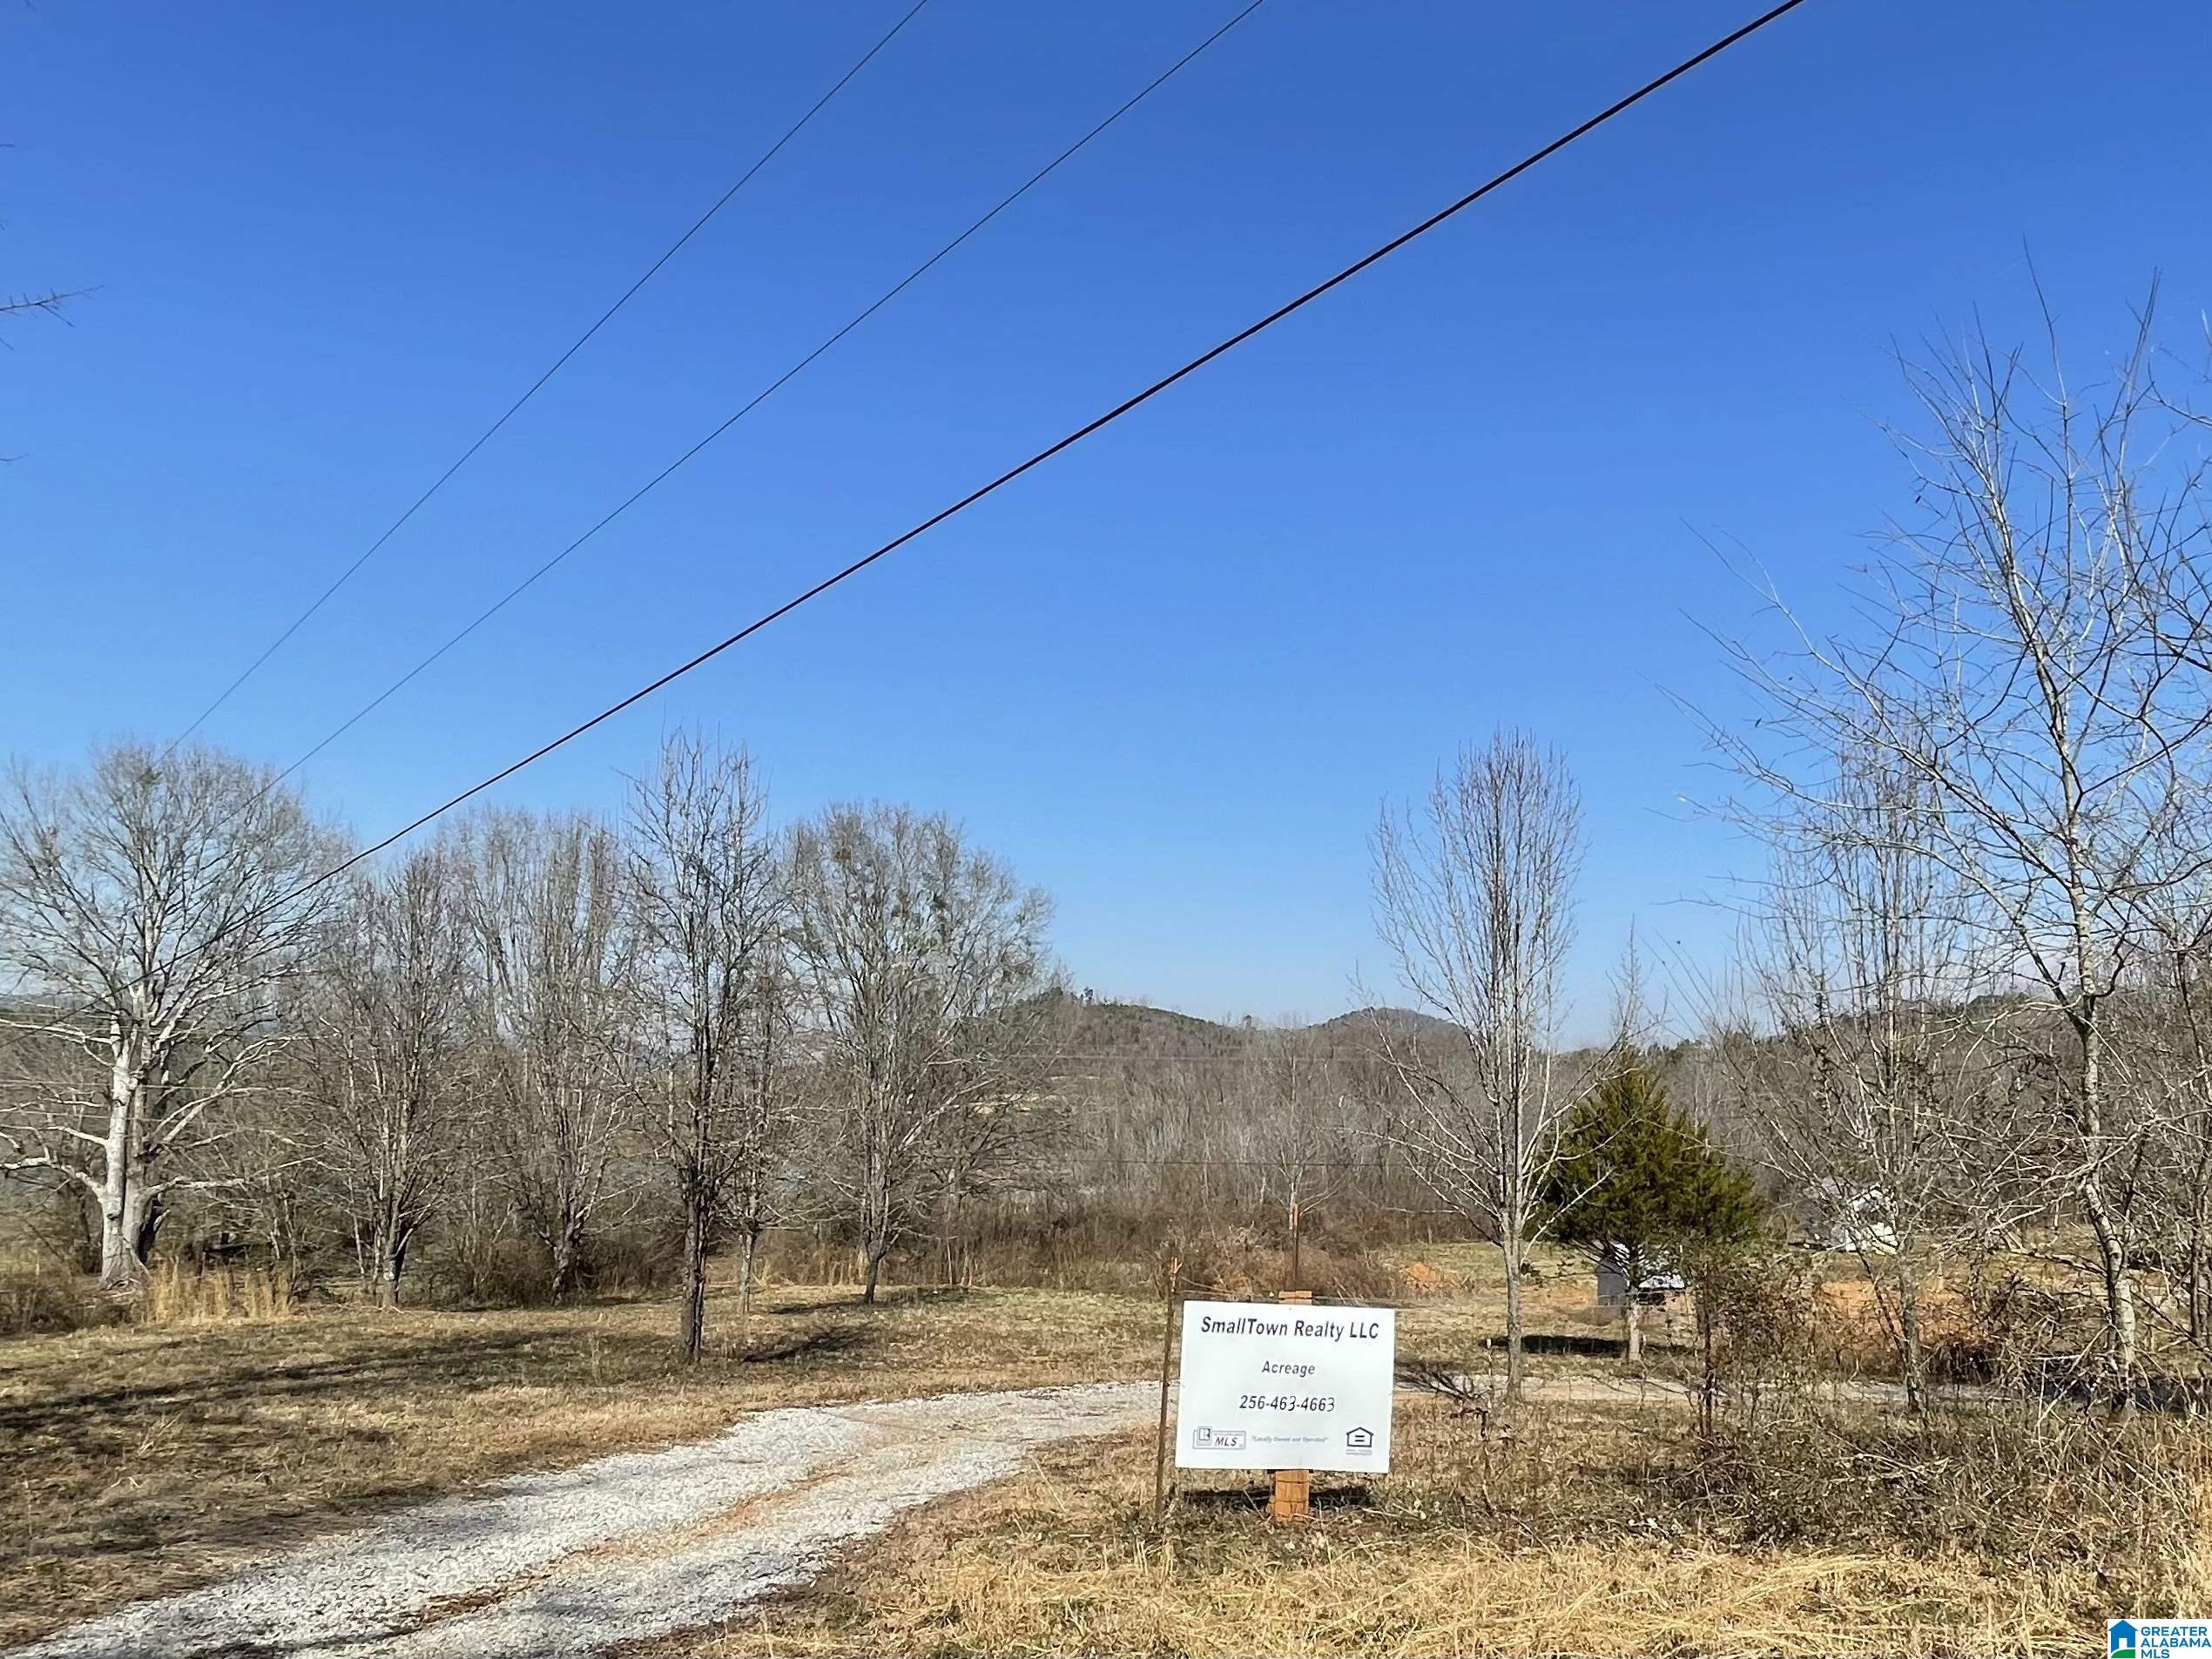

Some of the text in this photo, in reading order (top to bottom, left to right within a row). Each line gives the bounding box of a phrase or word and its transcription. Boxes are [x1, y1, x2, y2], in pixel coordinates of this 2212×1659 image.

[1200, 1316, 1379, 1342] SmallTown Realty LLC
[1261, 1360, 1316, 1377] Acreage
[1238, 1394, 1335, 1412] 256-463-4663
[1215, 1437, 1238, 1447] MLS
